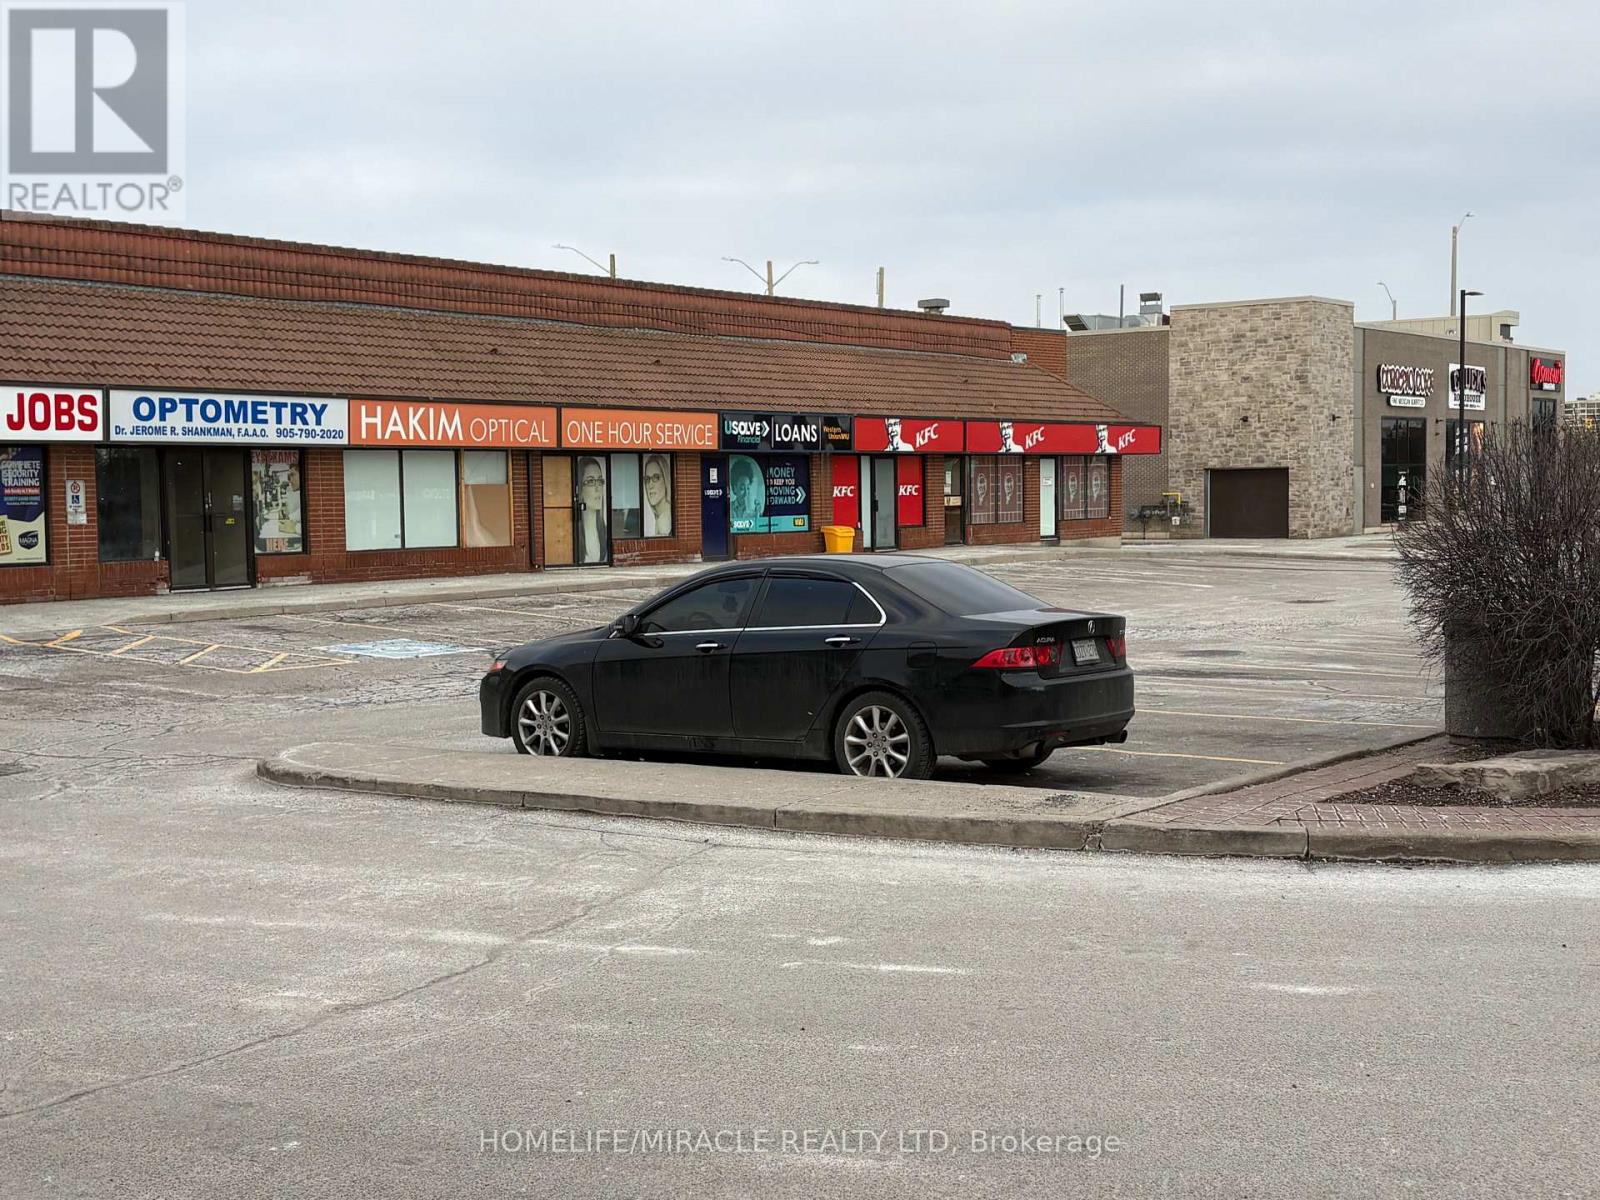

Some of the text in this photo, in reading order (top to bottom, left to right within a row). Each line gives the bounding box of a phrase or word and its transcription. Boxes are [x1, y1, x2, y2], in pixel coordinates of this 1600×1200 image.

[6, 392, 98, 432] JOBS
[132, 396, 329, 426] OPTOMETRY
[115, 425, 344, 440] Dr. JEROME R. SHANKMAN, F.A.A.O. 905-790-2020
[360, 404, 550, 443] HAKIM OPTICAL
[567, 420, 713, 445] ONE HOUR SERVICE
[724, 420, 761, 436] USOLVE
[775, 423, 818, 442] LOANS
[737, 435, 761, 444] Financial
[915, 423, 939, 448] KFC
[1025, 426, 1046, 449] KFC
[1118, 429, 1136, 450] KFC
[833, 486, 854, 497] KFC
[898, 485, 919, 496] KFC
